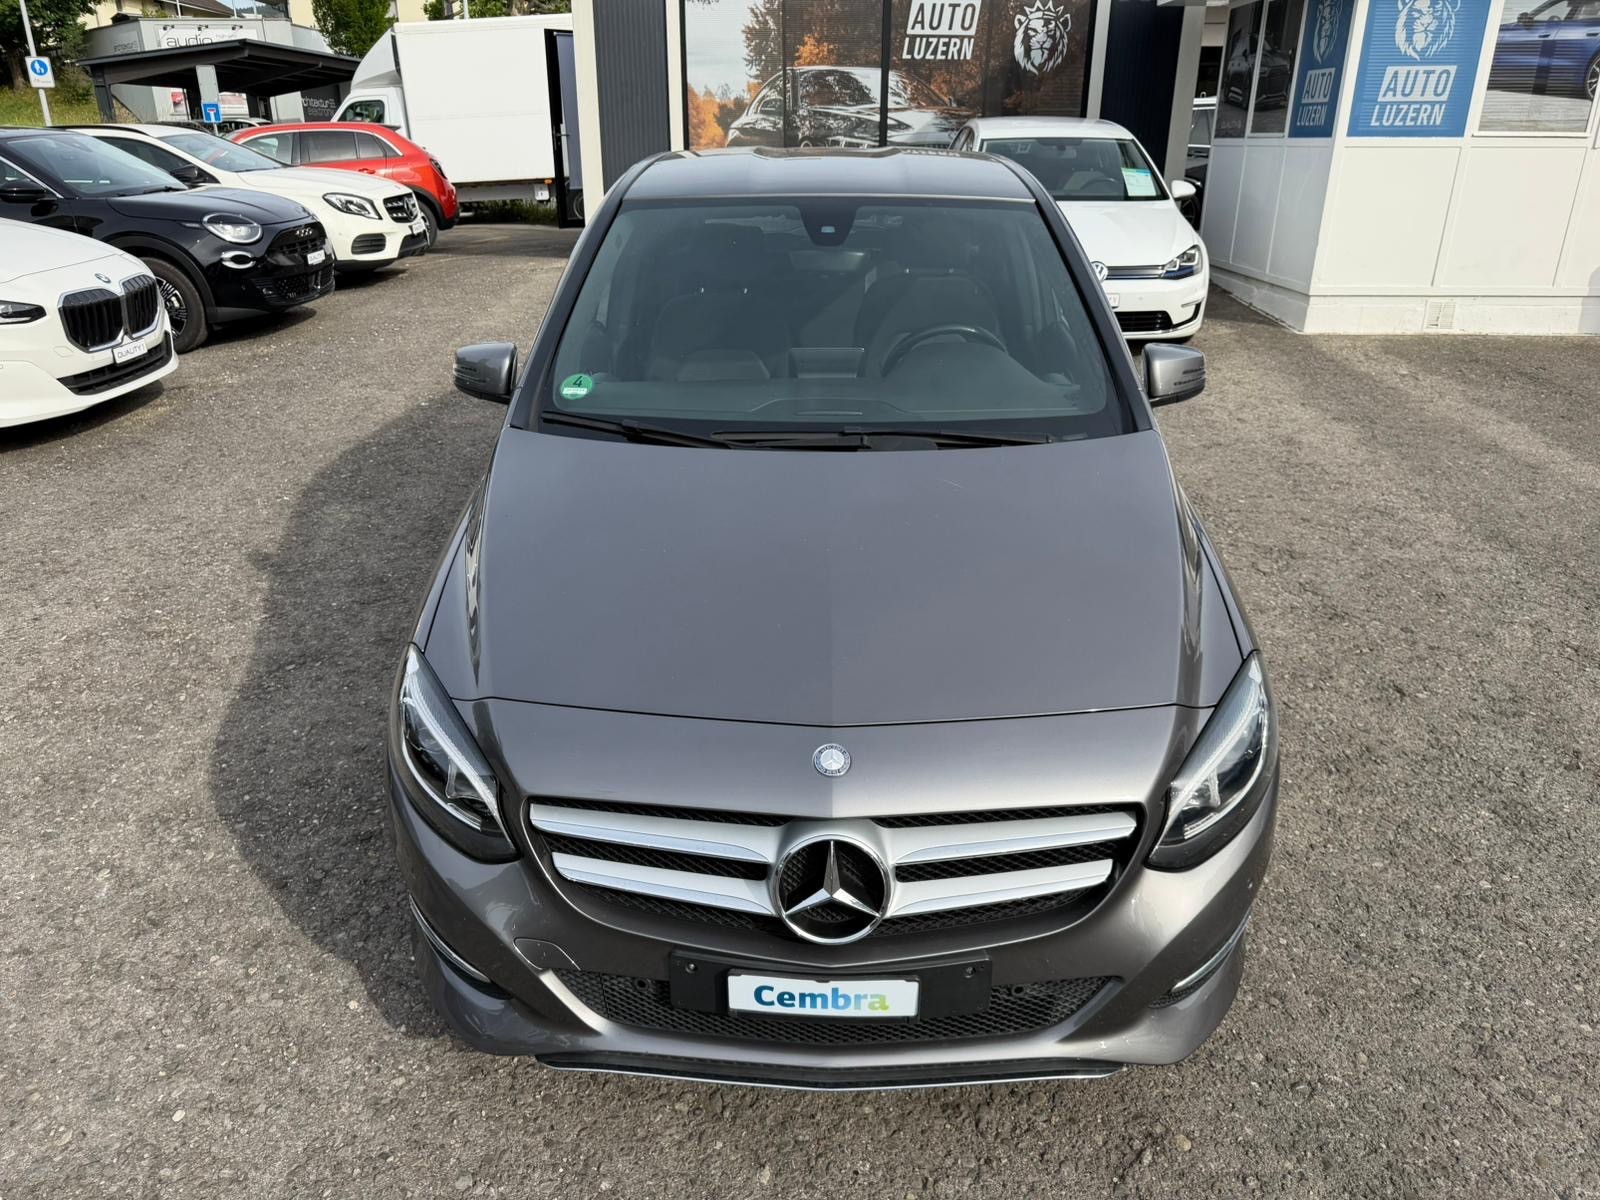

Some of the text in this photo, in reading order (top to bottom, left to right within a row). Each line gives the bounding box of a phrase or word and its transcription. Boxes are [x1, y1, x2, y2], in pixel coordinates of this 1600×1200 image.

[910, 2, 977, 31] AUTO
[166, 34, 213, 47] audio
[902, 36, 974, 60] LUZERN
[1303, 72, 1332, 100] AUTO
[1382, 69, 1452, 97] AUTO
[1296, 104, 1328, 126] LUZERN
[1370, 104, 1446, 127] LUZERN
[573, 375, 583, 387] 4
[753, 984, 890, 1011] Cembra
